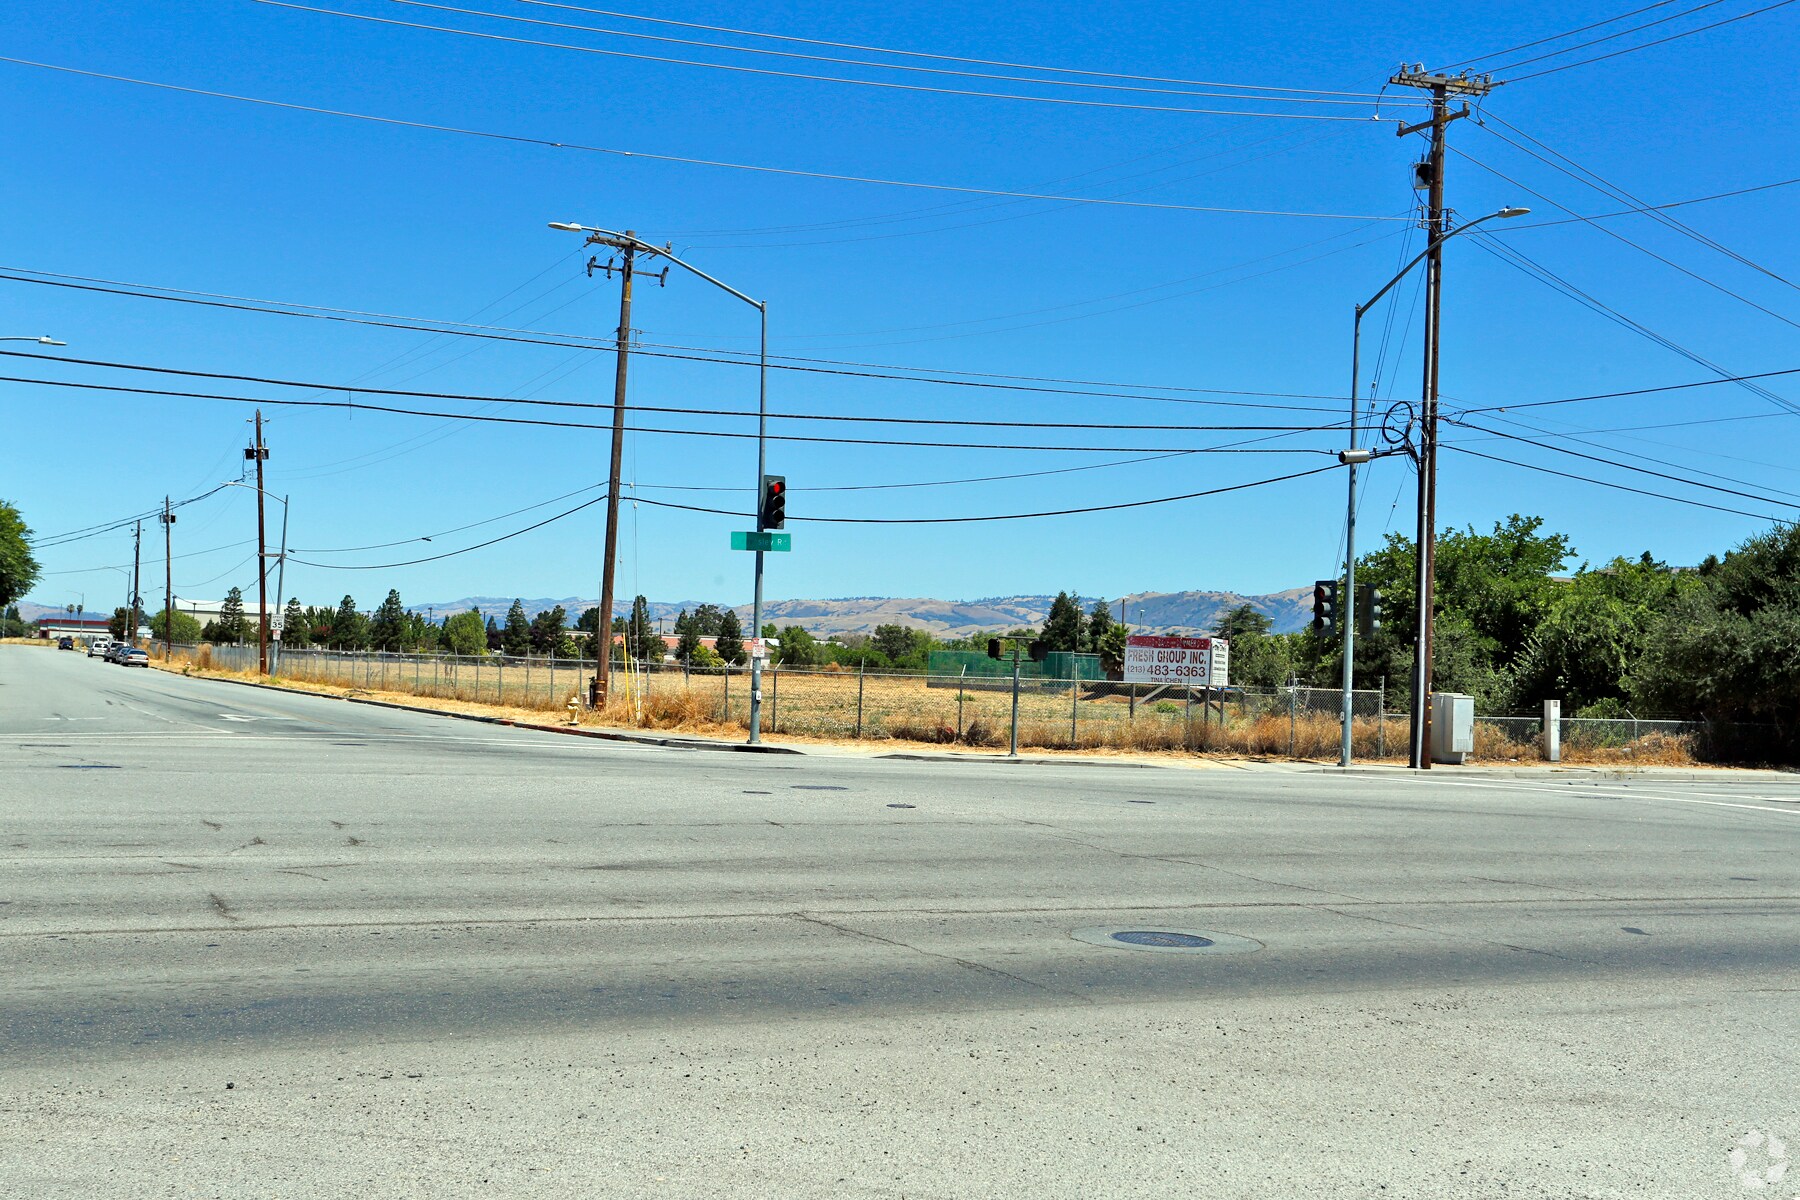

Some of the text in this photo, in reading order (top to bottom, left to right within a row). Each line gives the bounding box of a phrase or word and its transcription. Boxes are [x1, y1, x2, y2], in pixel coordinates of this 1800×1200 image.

[272, 621, 283, 629] 35
[1128, 649, 1207, 664] FRESH GROUP INC.
[1127, 665, 1145, 673] (213)
[1147, 665, 1206, 677] 483-6363
